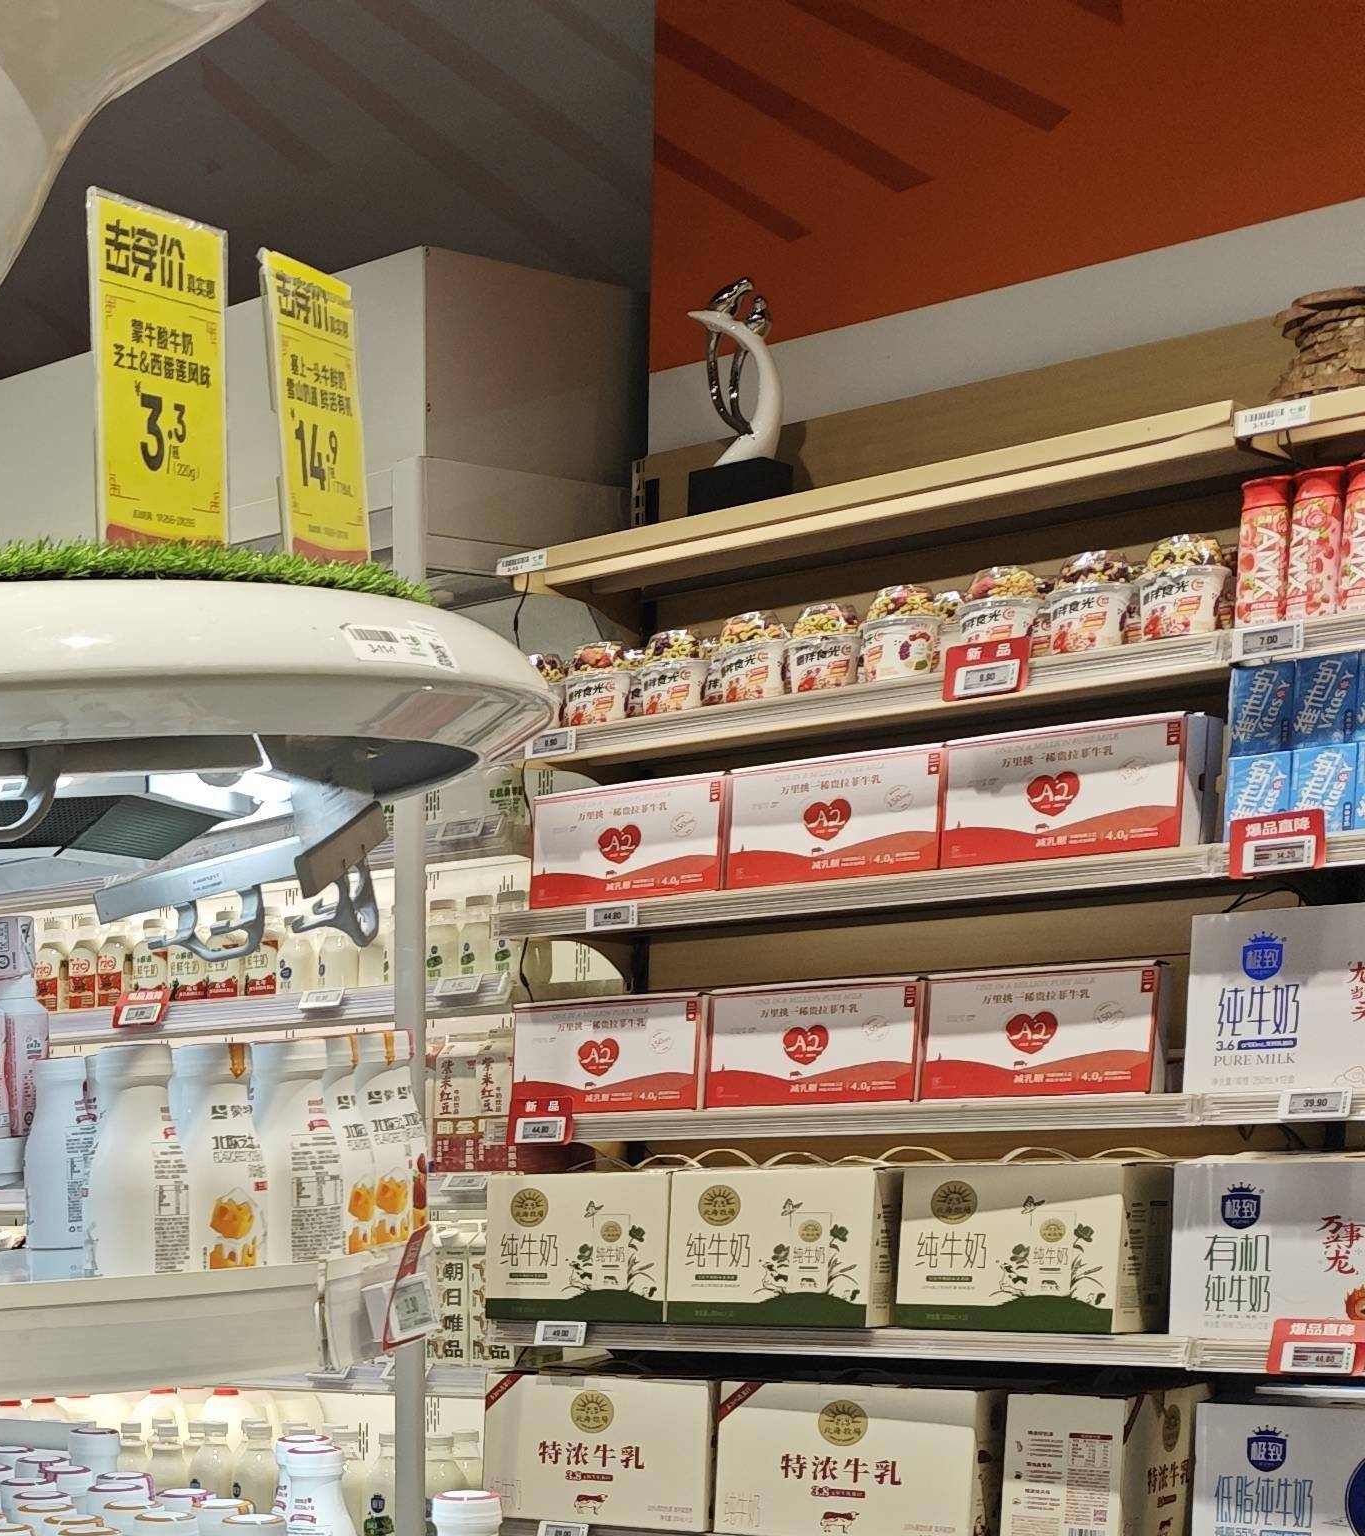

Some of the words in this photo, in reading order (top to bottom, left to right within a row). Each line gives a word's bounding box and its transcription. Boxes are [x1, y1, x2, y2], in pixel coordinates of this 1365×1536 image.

[105, 219, 185, 292] 击穿价
[130, 319, 194, 357] 蒙牛酸牛奶
[966, 642, 1012, 661] 新品
[1027, 783, 1074, 804] A2
[807, 809, 846, 828] A2
[1245, 817, 1310, 837] 爆品直降
[601, 833, 637, 853] A2
[1217, 983, 1300, 1037] 纯牛奶
[1008, 1022, 1051, 1040] A2
[785, 1035, 823, 1052] A2
[1216, 1040, 1235, 1051] 3.6
[580, 1048, 615, 1064] A2
[1213, 1054, 1252, 1067] PURE
[1256, 1052, 1296, 1066] MILK
[439, 1060, 455, 1116] 紫米红豆
[525, 1100, 560, 1113] 新品
[500, 1232, 558, 1267] 纯牛奶
[596, 1246, 626, 1263] 纯牛奶
[685, 1232, 751, 1268] 纯牛奶
[793, 1246, 826, 1264] 纯牛奶
[915, 1231, 987, 1269] 纯牛奶
[1033, 1247, 1069, 1265] 纯牛奶
[1203, 1234, 1272, 1272] 有机
[1205, 1275, 1271, 1313] 纯牛奶
[445, 1262, 464, 1358] 朝日唯品
[1290, 1323, 1355, 1337] 爆品直降
[538, 1441, 645, 1470] 特浓牛乳
[781, 1454, 902, 1486] 特浓牛乳
[1214, 1475, 1313, 1528] 低脂纯牛奶
